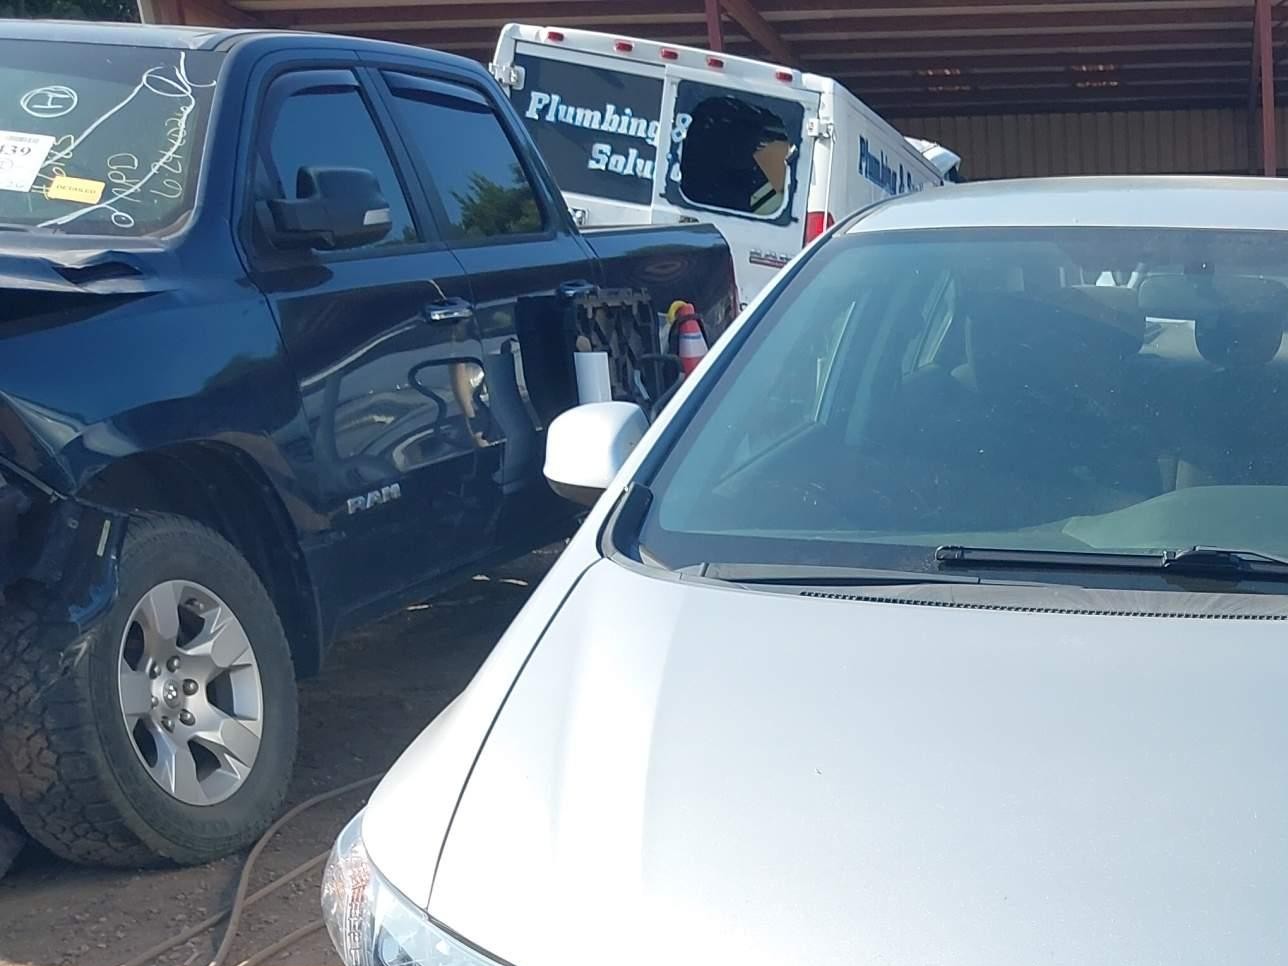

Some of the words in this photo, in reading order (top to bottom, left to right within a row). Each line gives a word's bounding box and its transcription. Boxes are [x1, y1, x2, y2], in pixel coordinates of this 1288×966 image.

[525, 91, 660, 147] Plumbing
[859, 134, 897, 195] Plumbing
[347, 483, 401, 515] RAM
